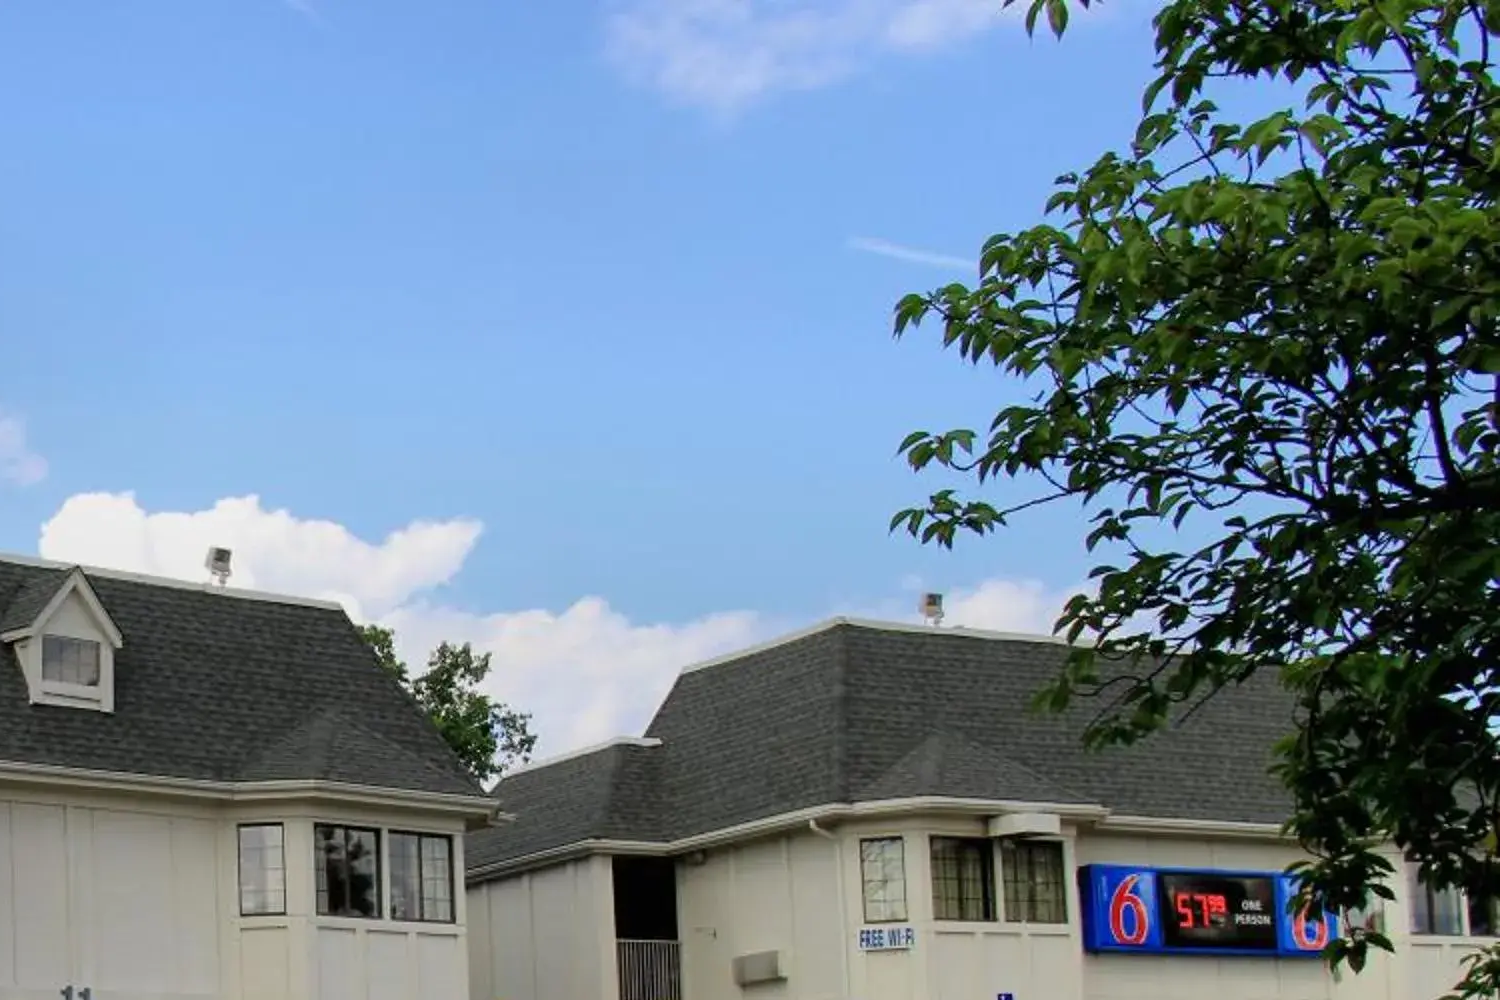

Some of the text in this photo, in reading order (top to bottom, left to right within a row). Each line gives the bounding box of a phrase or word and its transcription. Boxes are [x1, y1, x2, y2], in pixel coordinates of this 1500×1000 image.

[1110, 874, 1148, 945] 6
[1241, 899, 1263, 911] ONE
[1235, 913, 1271, 925] PERSON
[859, 927, 914, 948] FREE WI-FI
